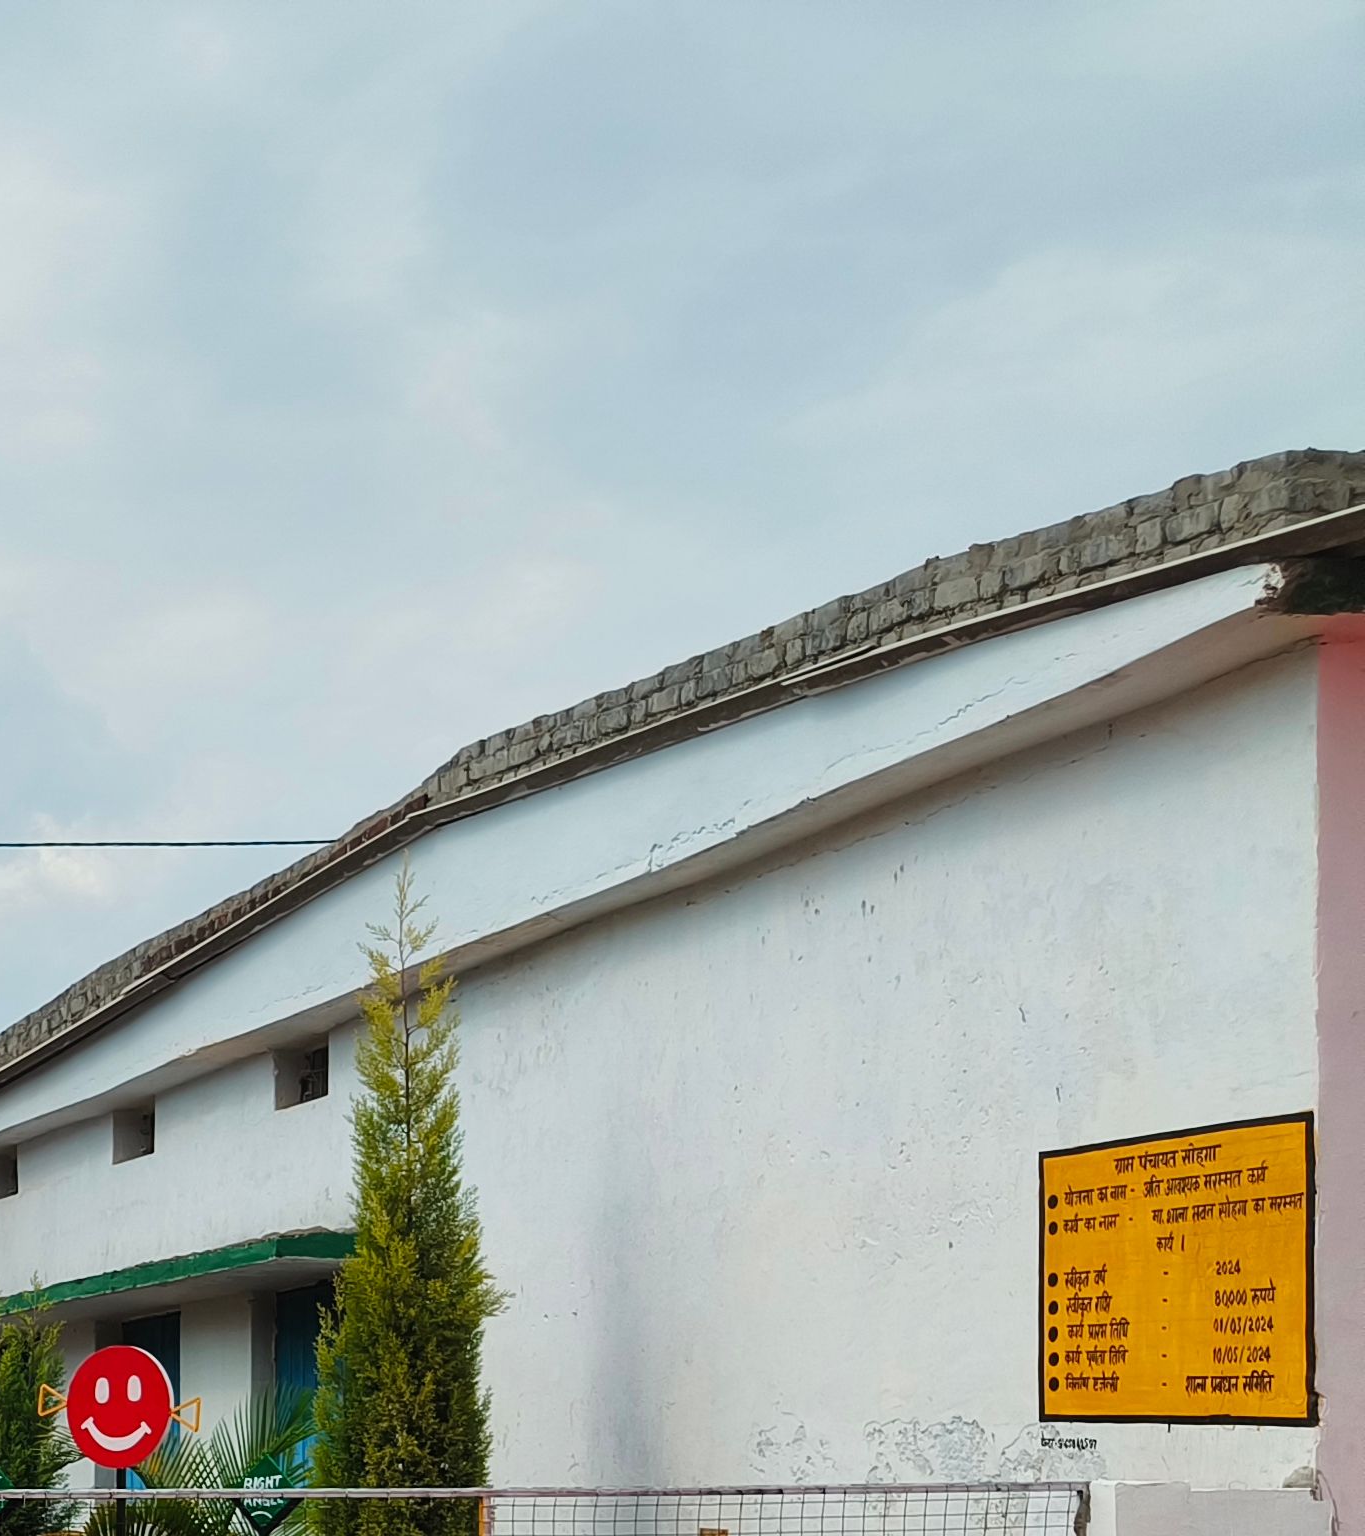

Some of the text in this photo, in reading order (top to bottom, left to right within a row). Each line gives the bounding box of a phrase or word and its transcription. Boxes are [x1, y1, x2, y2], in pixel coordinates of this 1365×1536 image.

[1137, 1150, 1179, 1170] पंचायत
[1215, 1259, 1241, 1276] 2024
[244, 1474, 283, 1489] RIGHT
